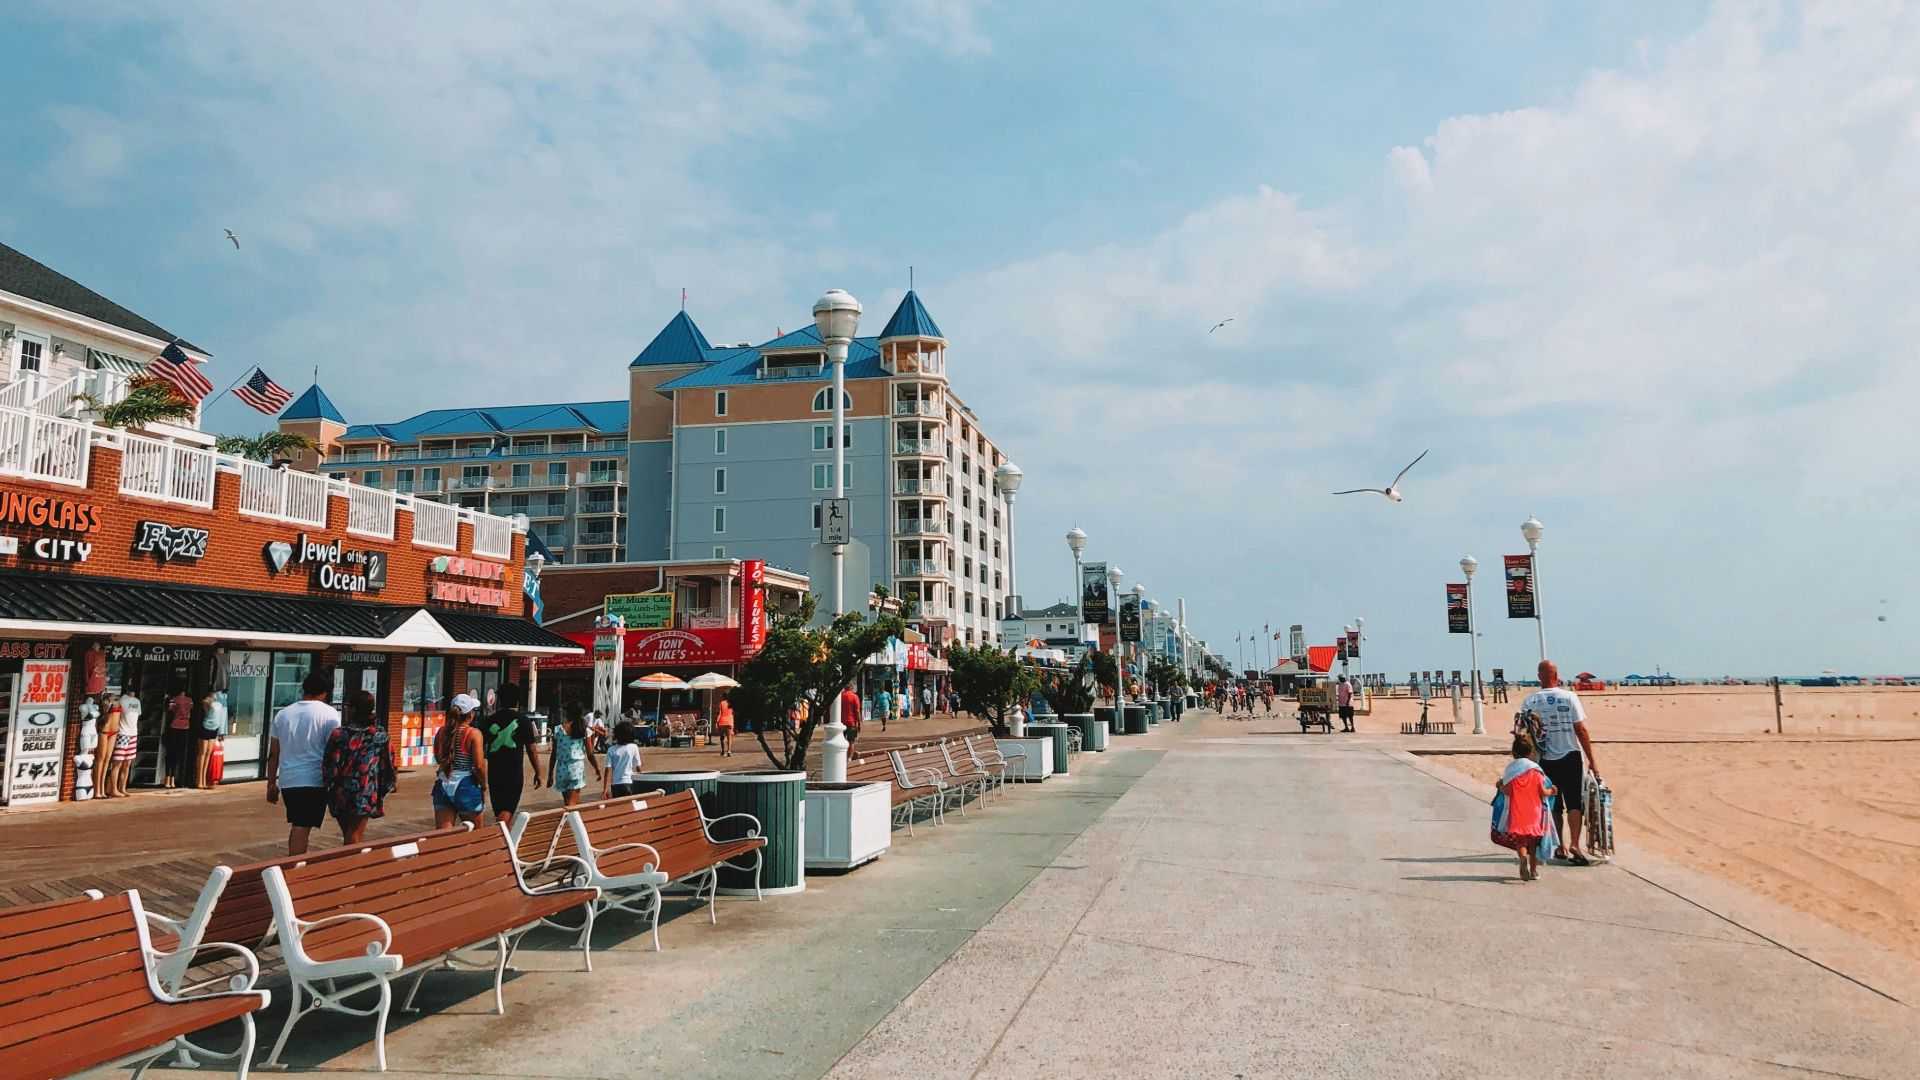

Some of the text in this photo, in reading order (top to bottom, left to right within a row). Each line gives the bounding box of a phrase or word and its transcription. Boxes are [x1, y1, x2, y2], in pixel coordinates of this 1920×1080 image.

[34, 538, 92, 562] CITY
[299, 533, 368, 564] Jewel of the
[447, 556, 504, 580] CANDY
[320, 564, 366, 592] Ocean
[436, 581, 510, 608] KITCHEN
[626, 596, 649, 604] Muze
[654, 594, 672, 602] Cafe
[658, 639, 684, 650] TONY
[34, 643, 69, 659] CITY
[144, 653, 170, 662] OAKLEY
[174, 650, 202, 661] STORE
[652, 649, 687, 660] LUKE'S
[26, 664, 70, 672] SUNGLASSES
[28, 672, 64, 693] $9.99
[22, 693, 29, 703] 2
[30, 693, 47, 702] FOR
[22, 728, 59, 736] OAKLEY
[22, 742, 56, 752] DEALER
